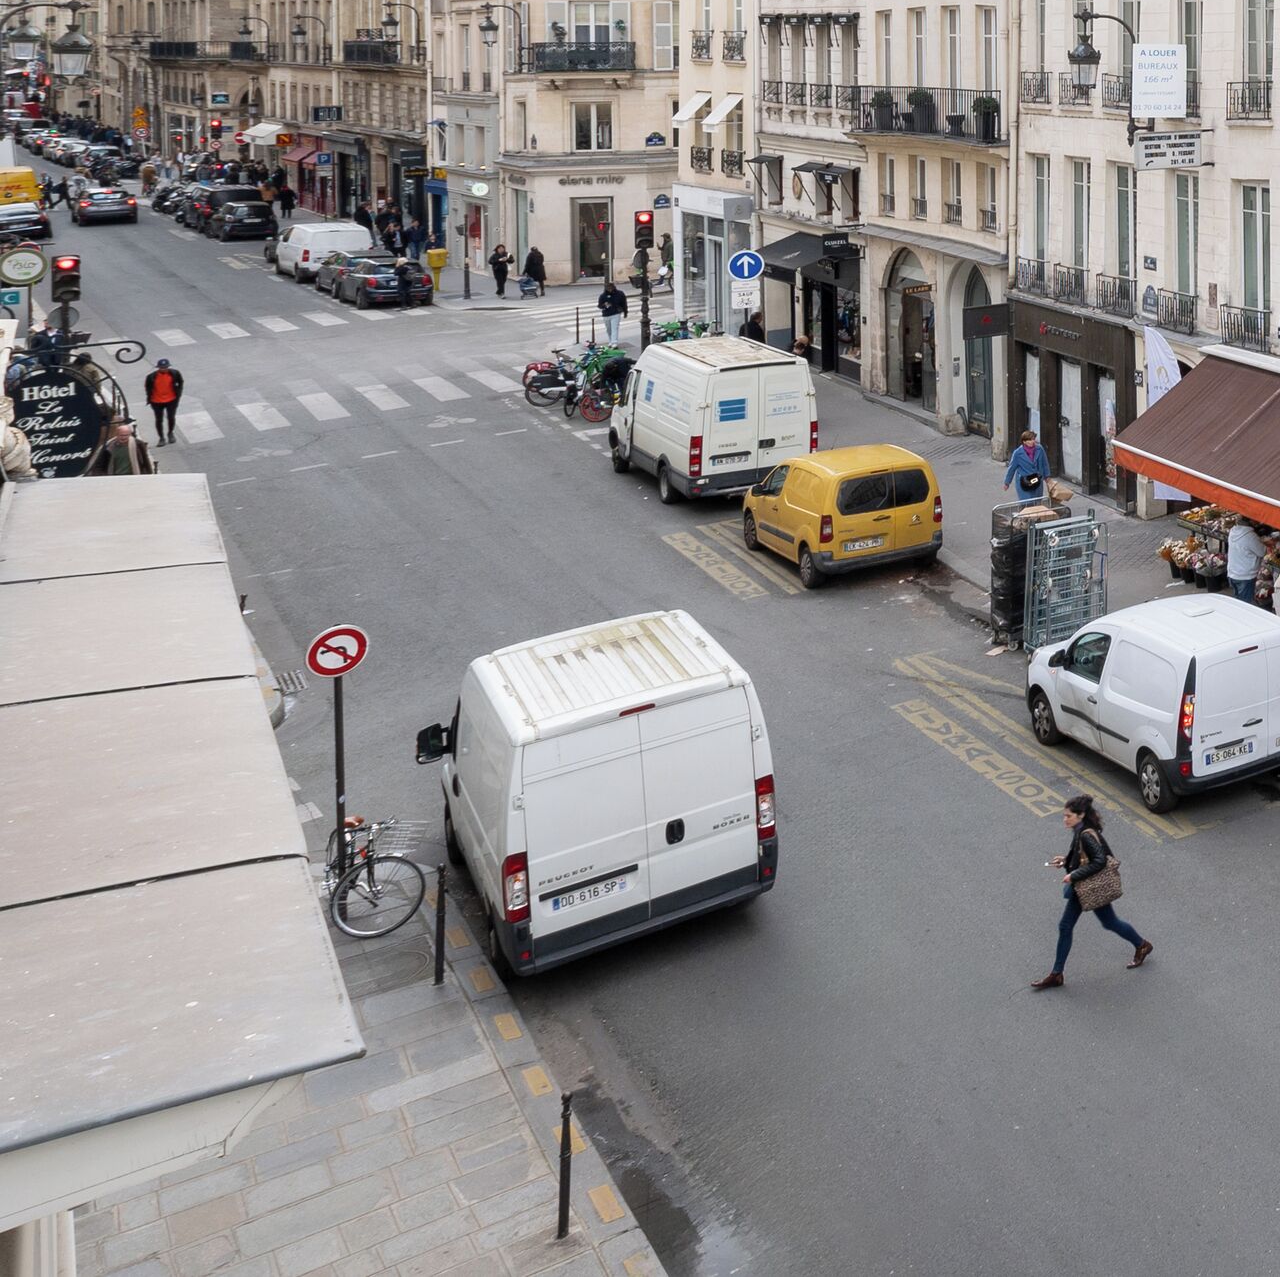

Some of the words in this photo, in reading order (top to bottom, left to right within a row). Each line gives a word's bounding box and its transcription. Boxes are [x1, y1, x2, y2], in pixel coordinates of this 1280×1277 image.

[1148, 49, 1177, 57] LOUER
[1137, 62, 1178, 71] BUREAUX
[558, 175, 594, 186] elena
[21, 381, 77, 402] Hôtel
[34, 400, 64, 415] Le
[15, 415, 82, 432] Relais
[28, 432, 76, 447] Saint
[896, 702, 1067, 814] LIVRAISON
[712, 814, 751, 830] BOXER
[538, 864, 595, 887] PEUGEOT
